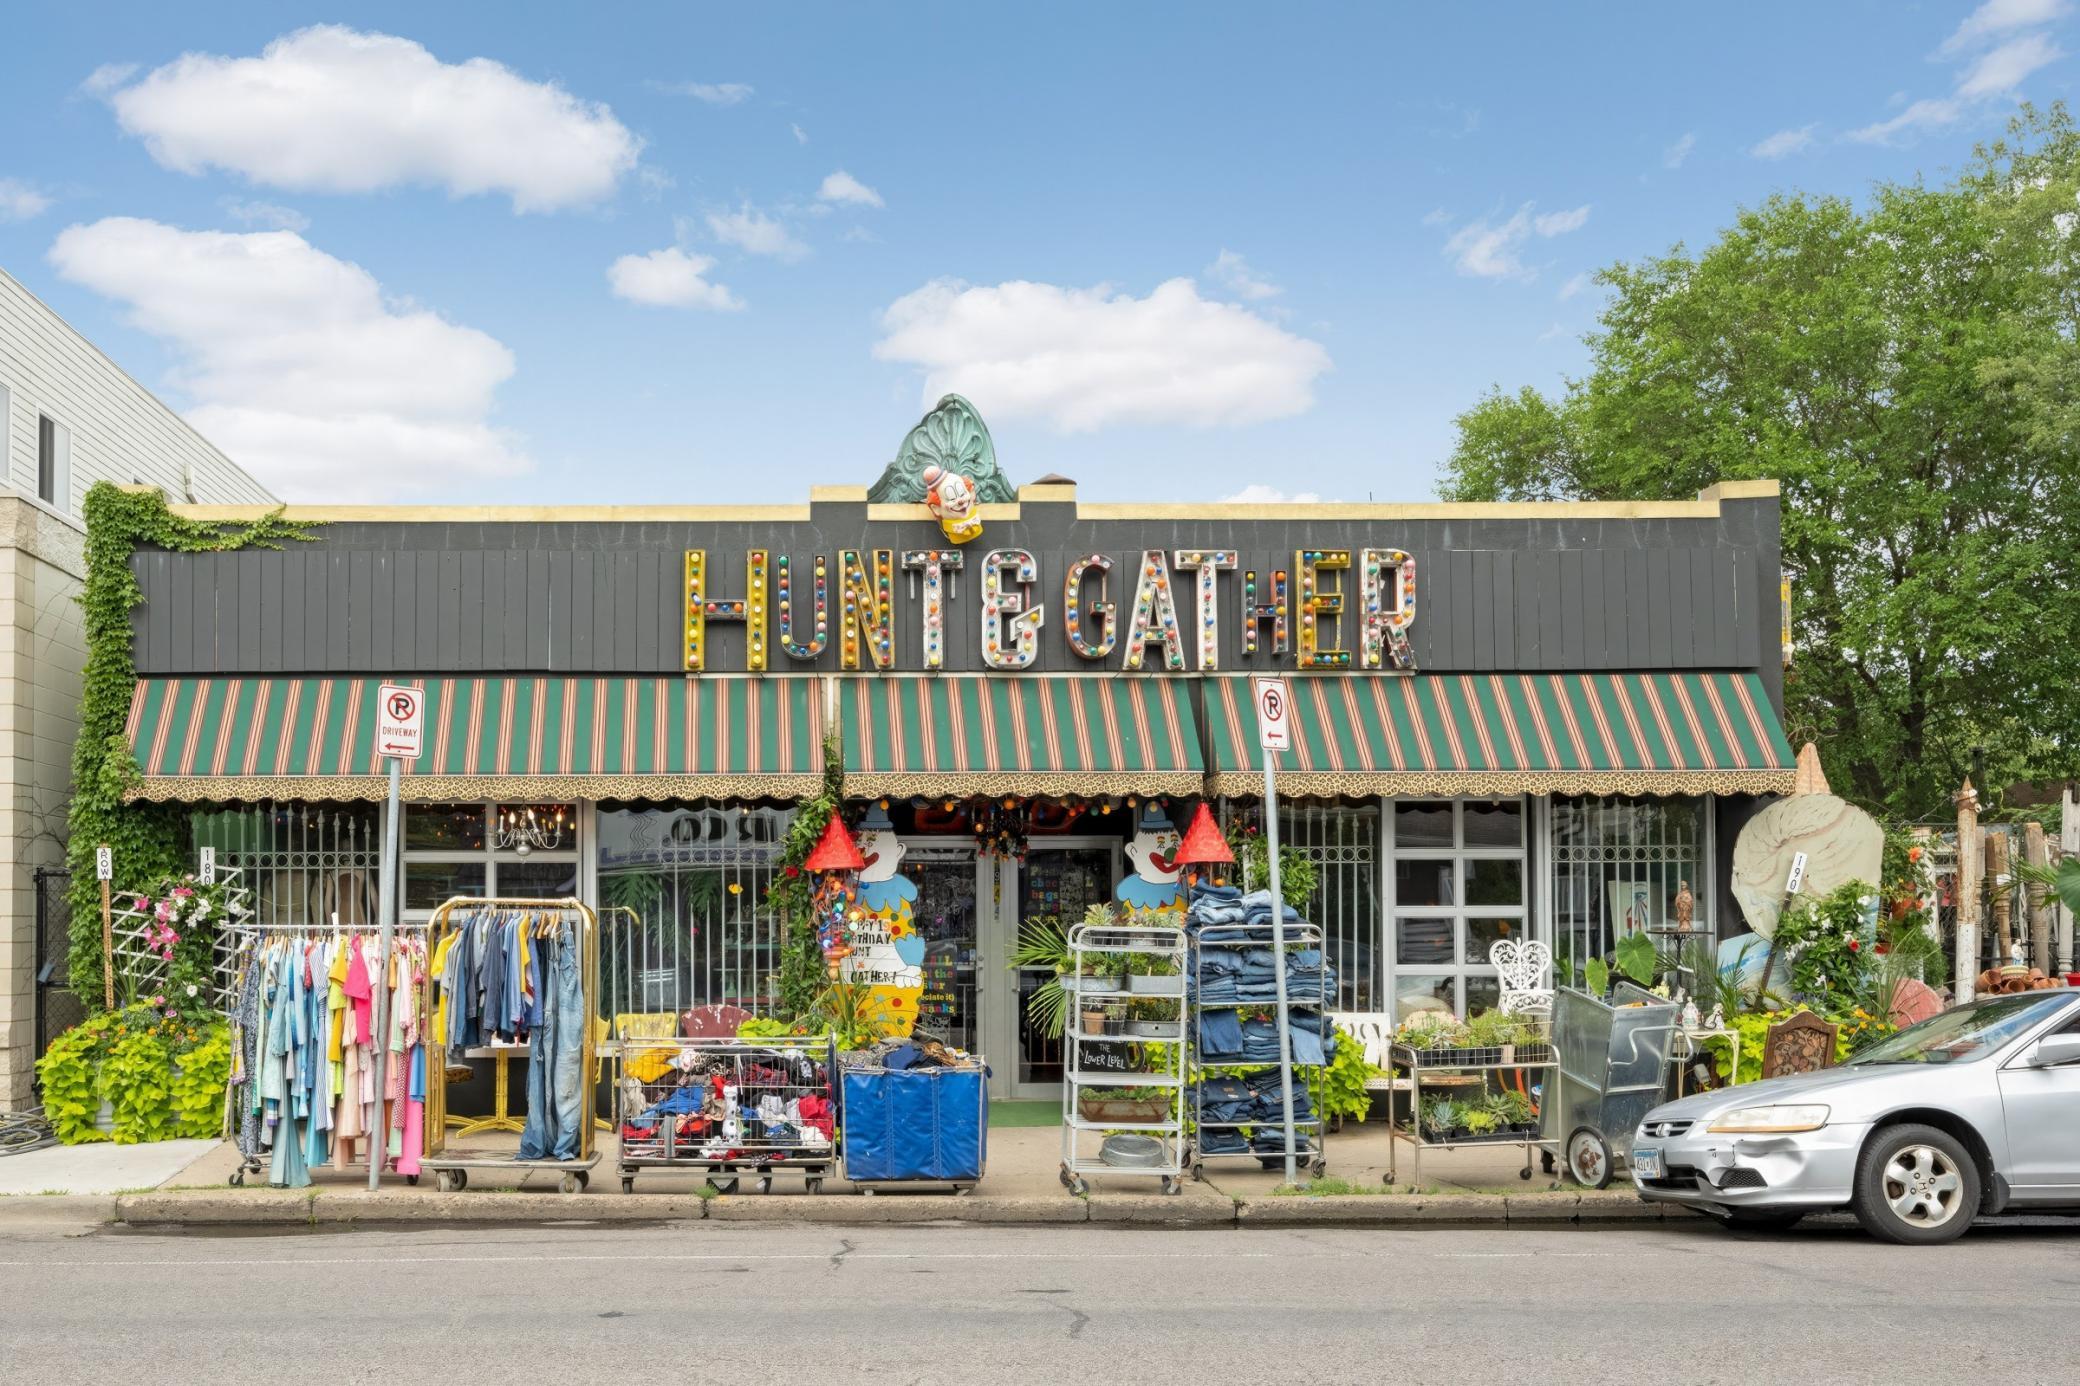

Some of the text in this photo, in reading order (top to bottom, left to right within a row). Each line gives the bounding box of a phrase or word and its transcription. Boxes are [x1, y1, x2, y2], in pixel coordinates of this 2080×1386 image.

[383, 727, 417, 738] DRIVEWAY
[1790, 855, 1803, 890] 190
[852, 946, 871, 957] UNT
[920, 1003, 955, 1014] hanks
[1099, 1043, 1110, 1053] THE
[1107, 1055, 1126, 1070] LEVEL
